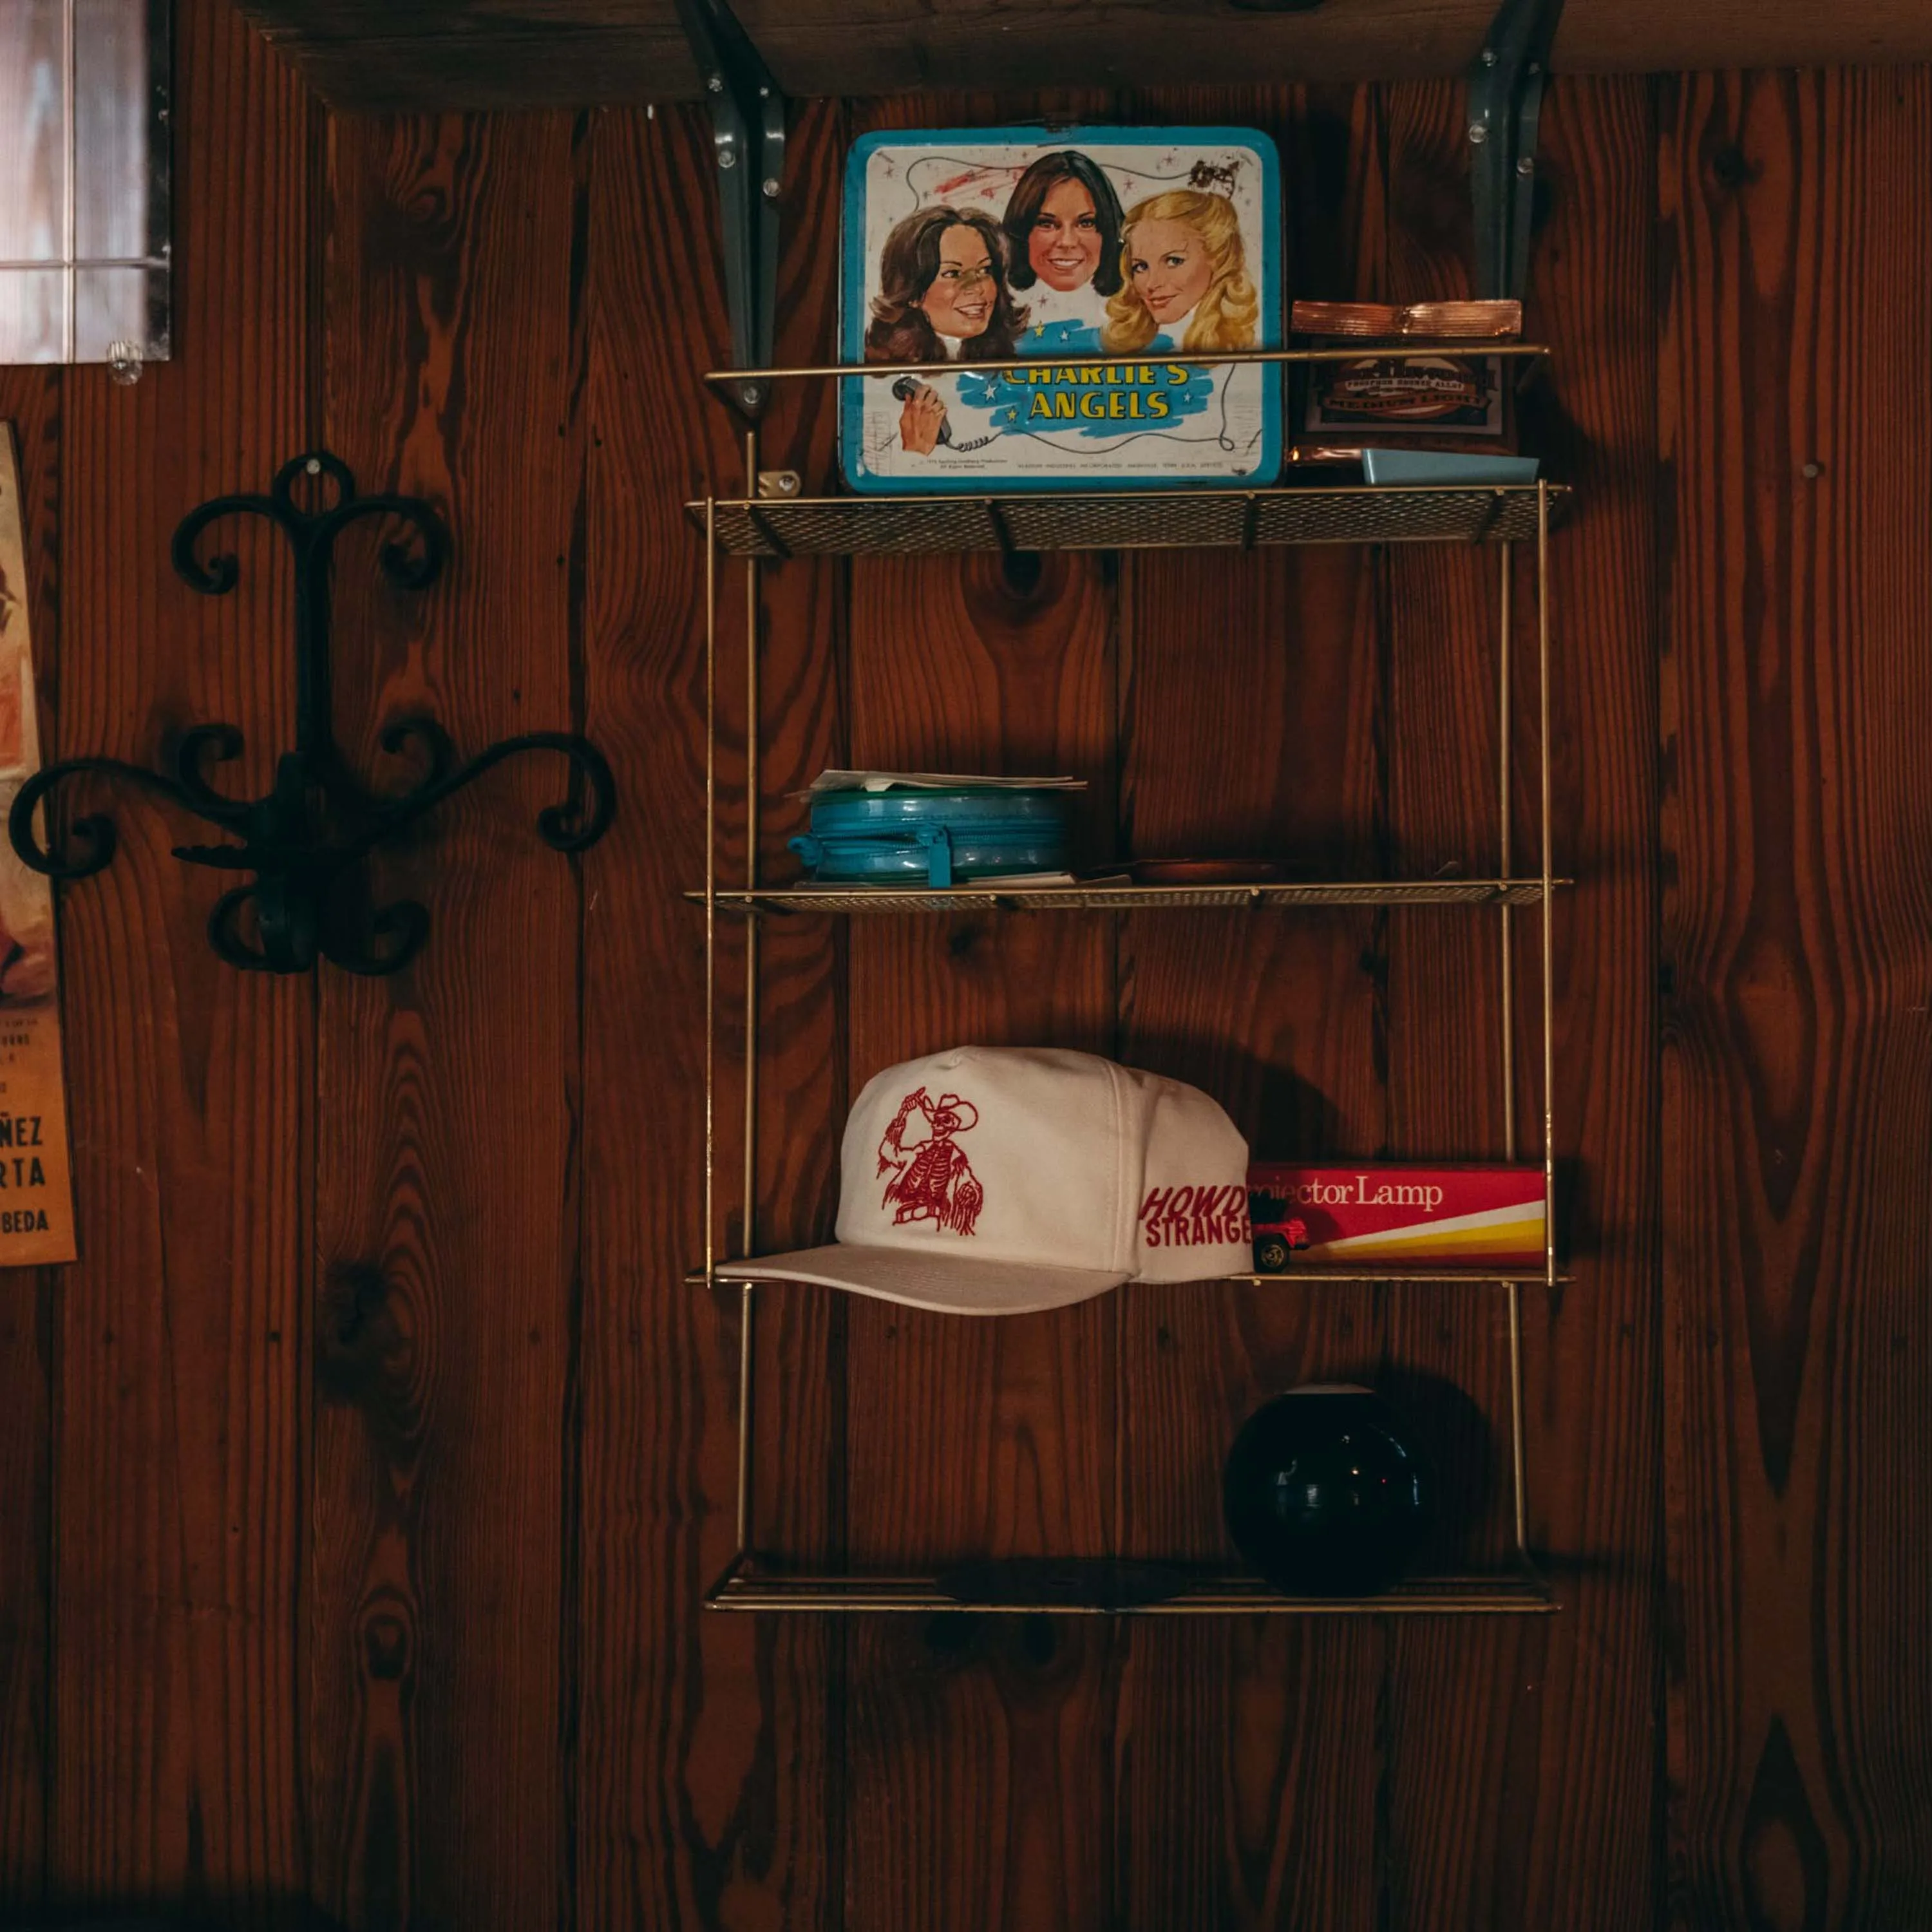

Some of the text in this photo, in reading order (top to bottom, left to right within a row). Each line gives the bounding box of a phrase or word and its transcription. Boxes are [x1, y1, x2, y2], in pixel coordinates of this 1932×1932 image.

[1002, 364, 1189, 385] CHARLIES
[1435, 380, 1463, 390] ALLOY
[1028, 391, 1170, 419] ANGELS
[1138, 1185, 1250, 1220] HOWD
[2, 1209, 50, 1233] BEDA
